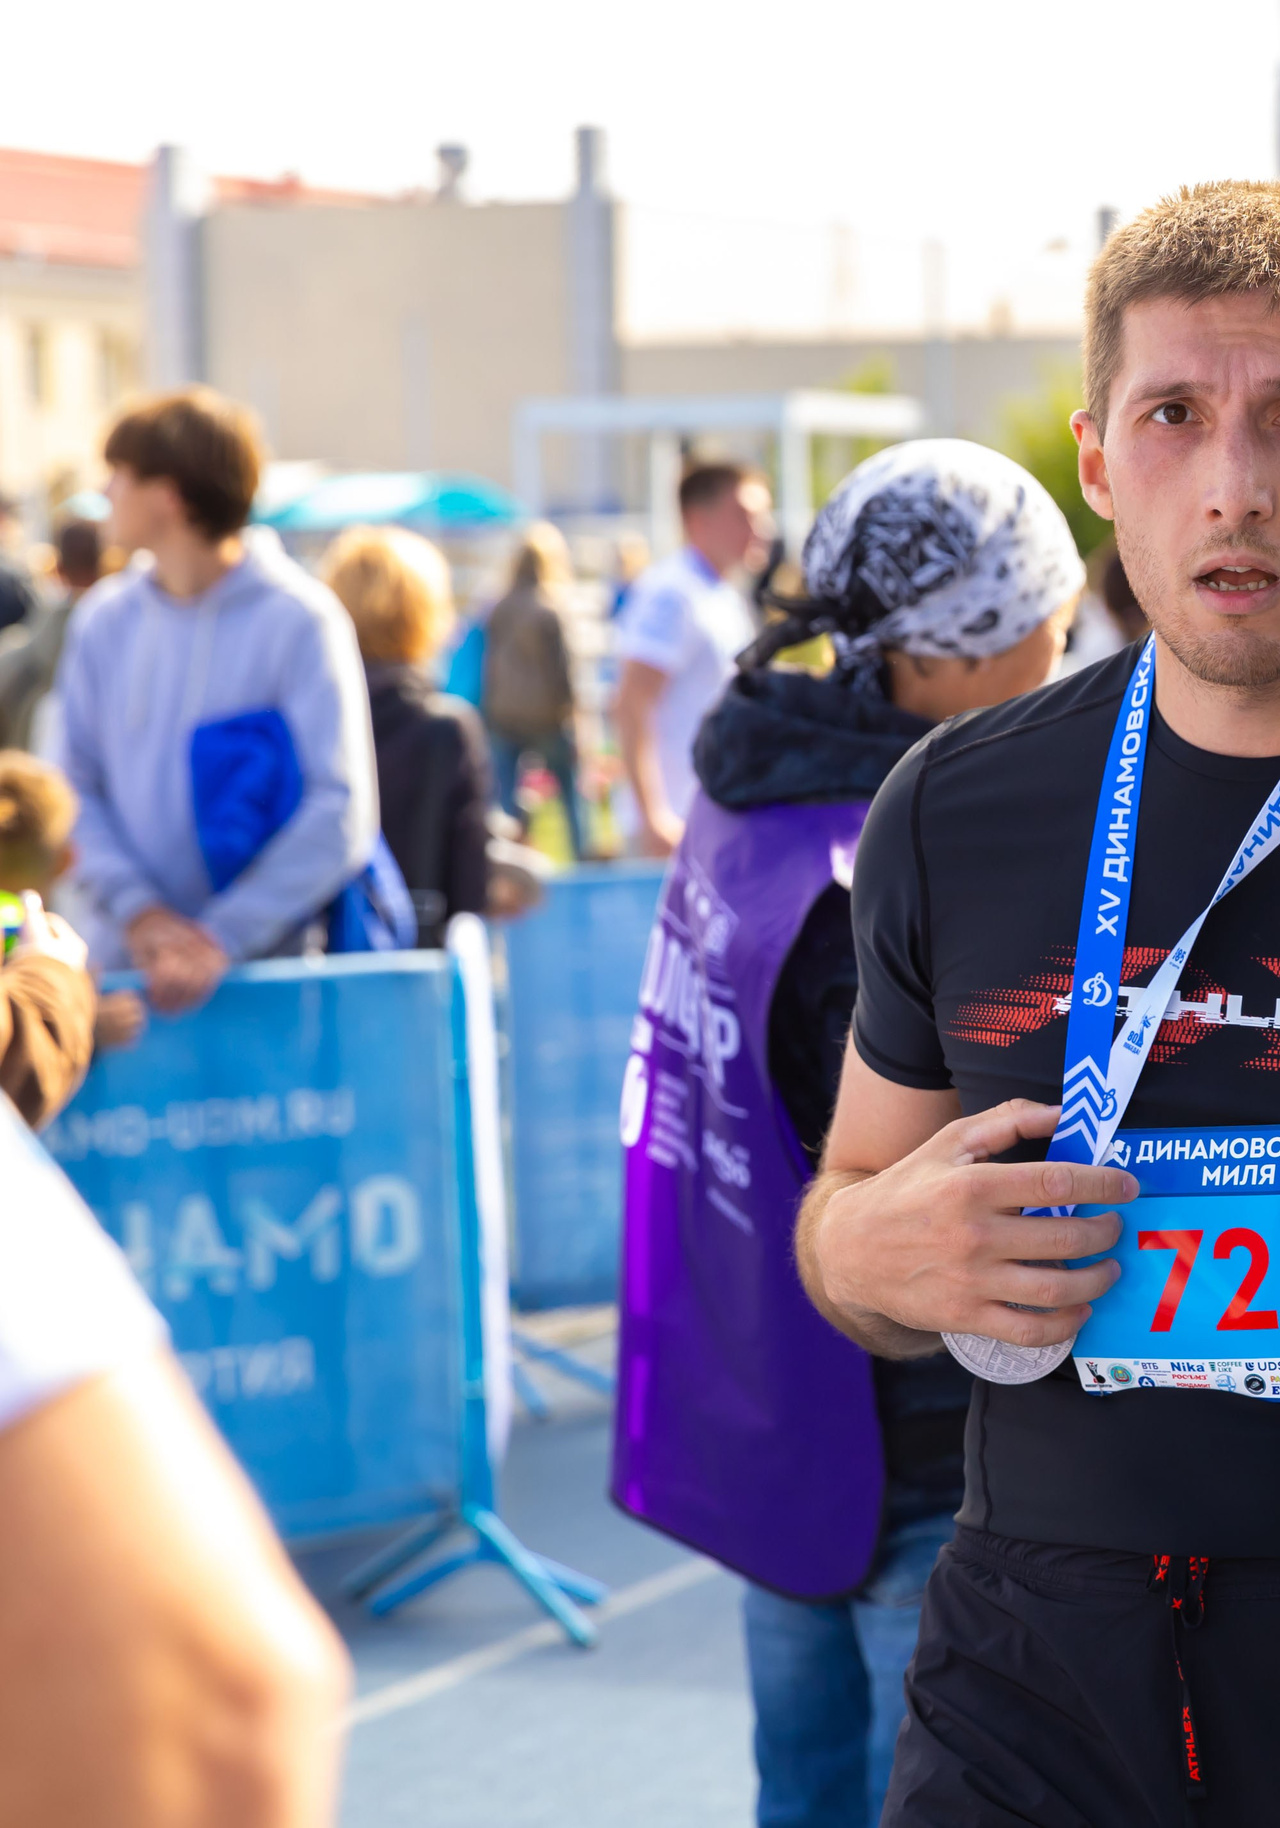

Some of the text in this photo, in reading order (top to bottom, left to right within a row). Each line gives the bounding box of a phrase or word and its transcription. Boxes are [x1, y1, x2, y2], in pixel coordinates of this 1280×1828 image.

[1095, 888, 1121, 937] XV
[1201, 1164, 1276, 1187] МИЛЯ
[1141, 1362, 1159, 1370] ВТБ
[1170, 1361, 1205, 1372] Nika
[1181, 1705, 1201, 1782] ATHLEX
